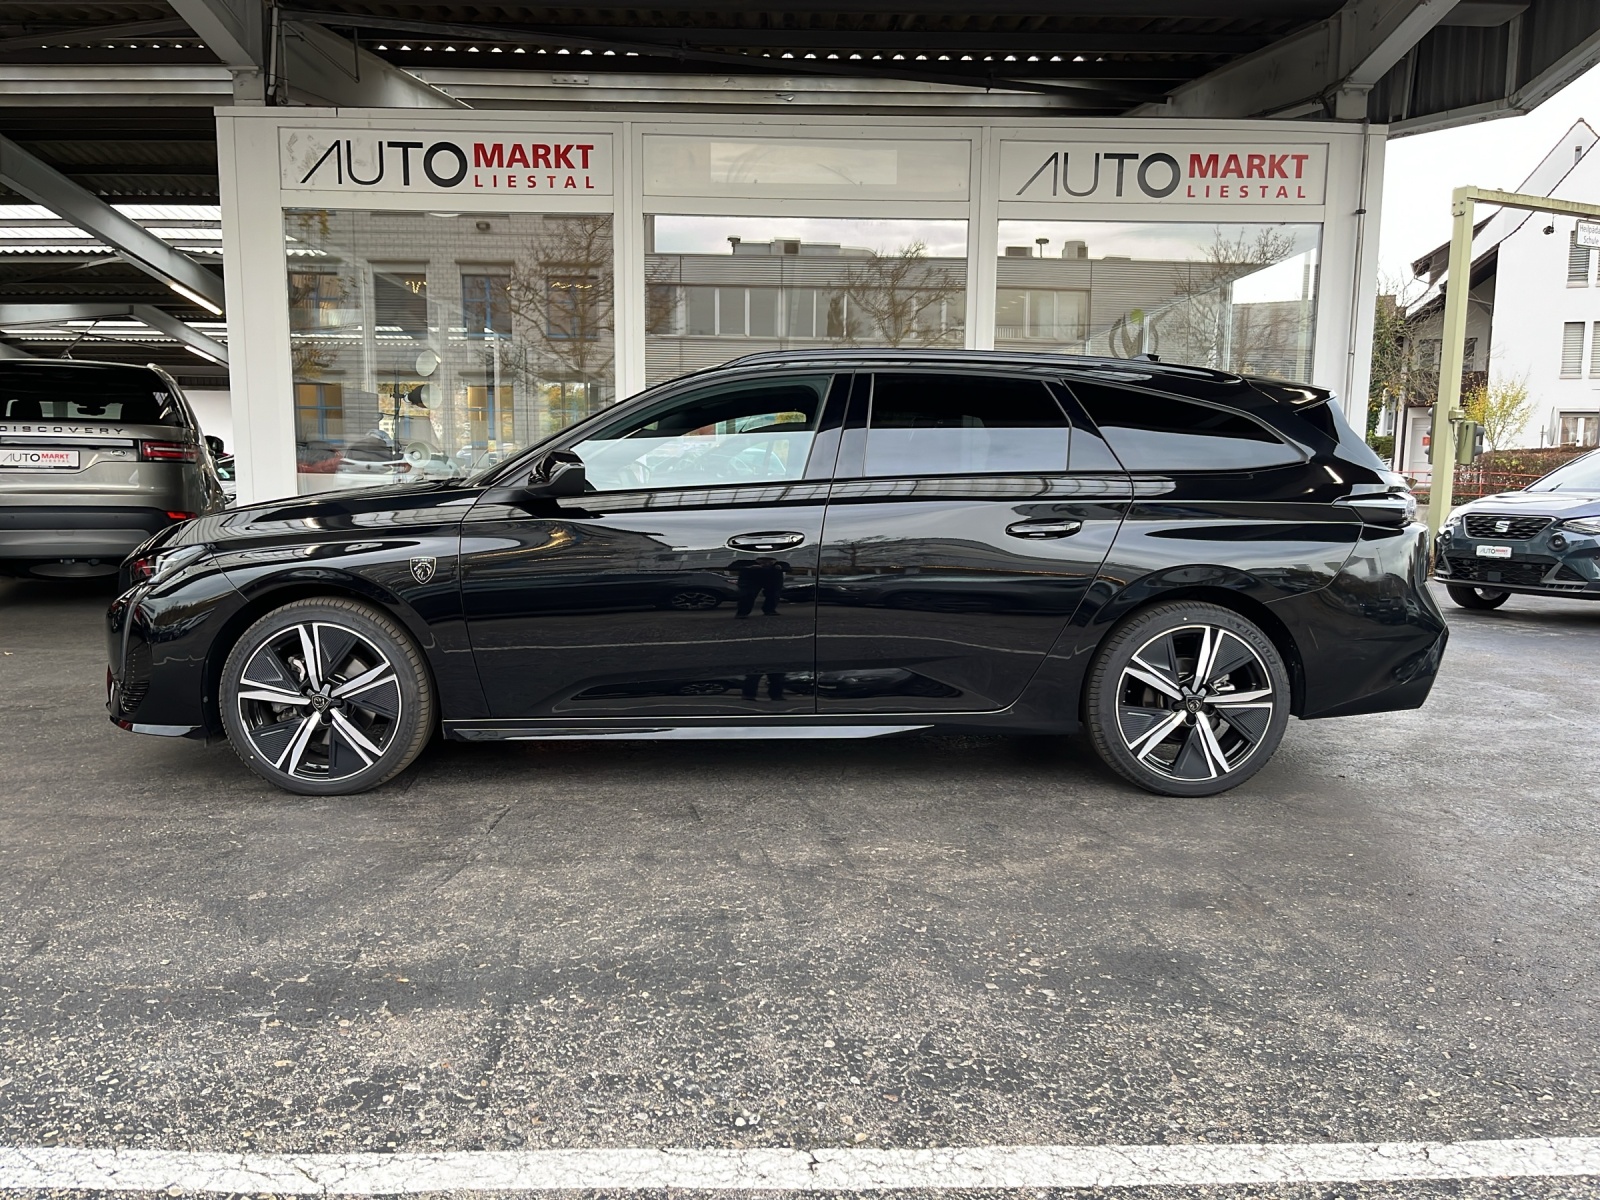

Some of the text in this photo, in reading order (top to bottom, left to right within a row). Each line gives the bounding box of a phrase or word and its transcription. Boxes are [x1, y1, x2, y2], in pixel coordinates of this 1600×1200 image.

[300, 140, 594, 188] AUTO MARKT
[474, 175, 595, 189] LIESTAL
[1016, 152, 1309, 199] AUTO MARKT
[1187, 185, 1306, 199] LIESTAL
[0, 425, 123, 435] DISCOVERY
[3, 453, 40, 462] AUTO
